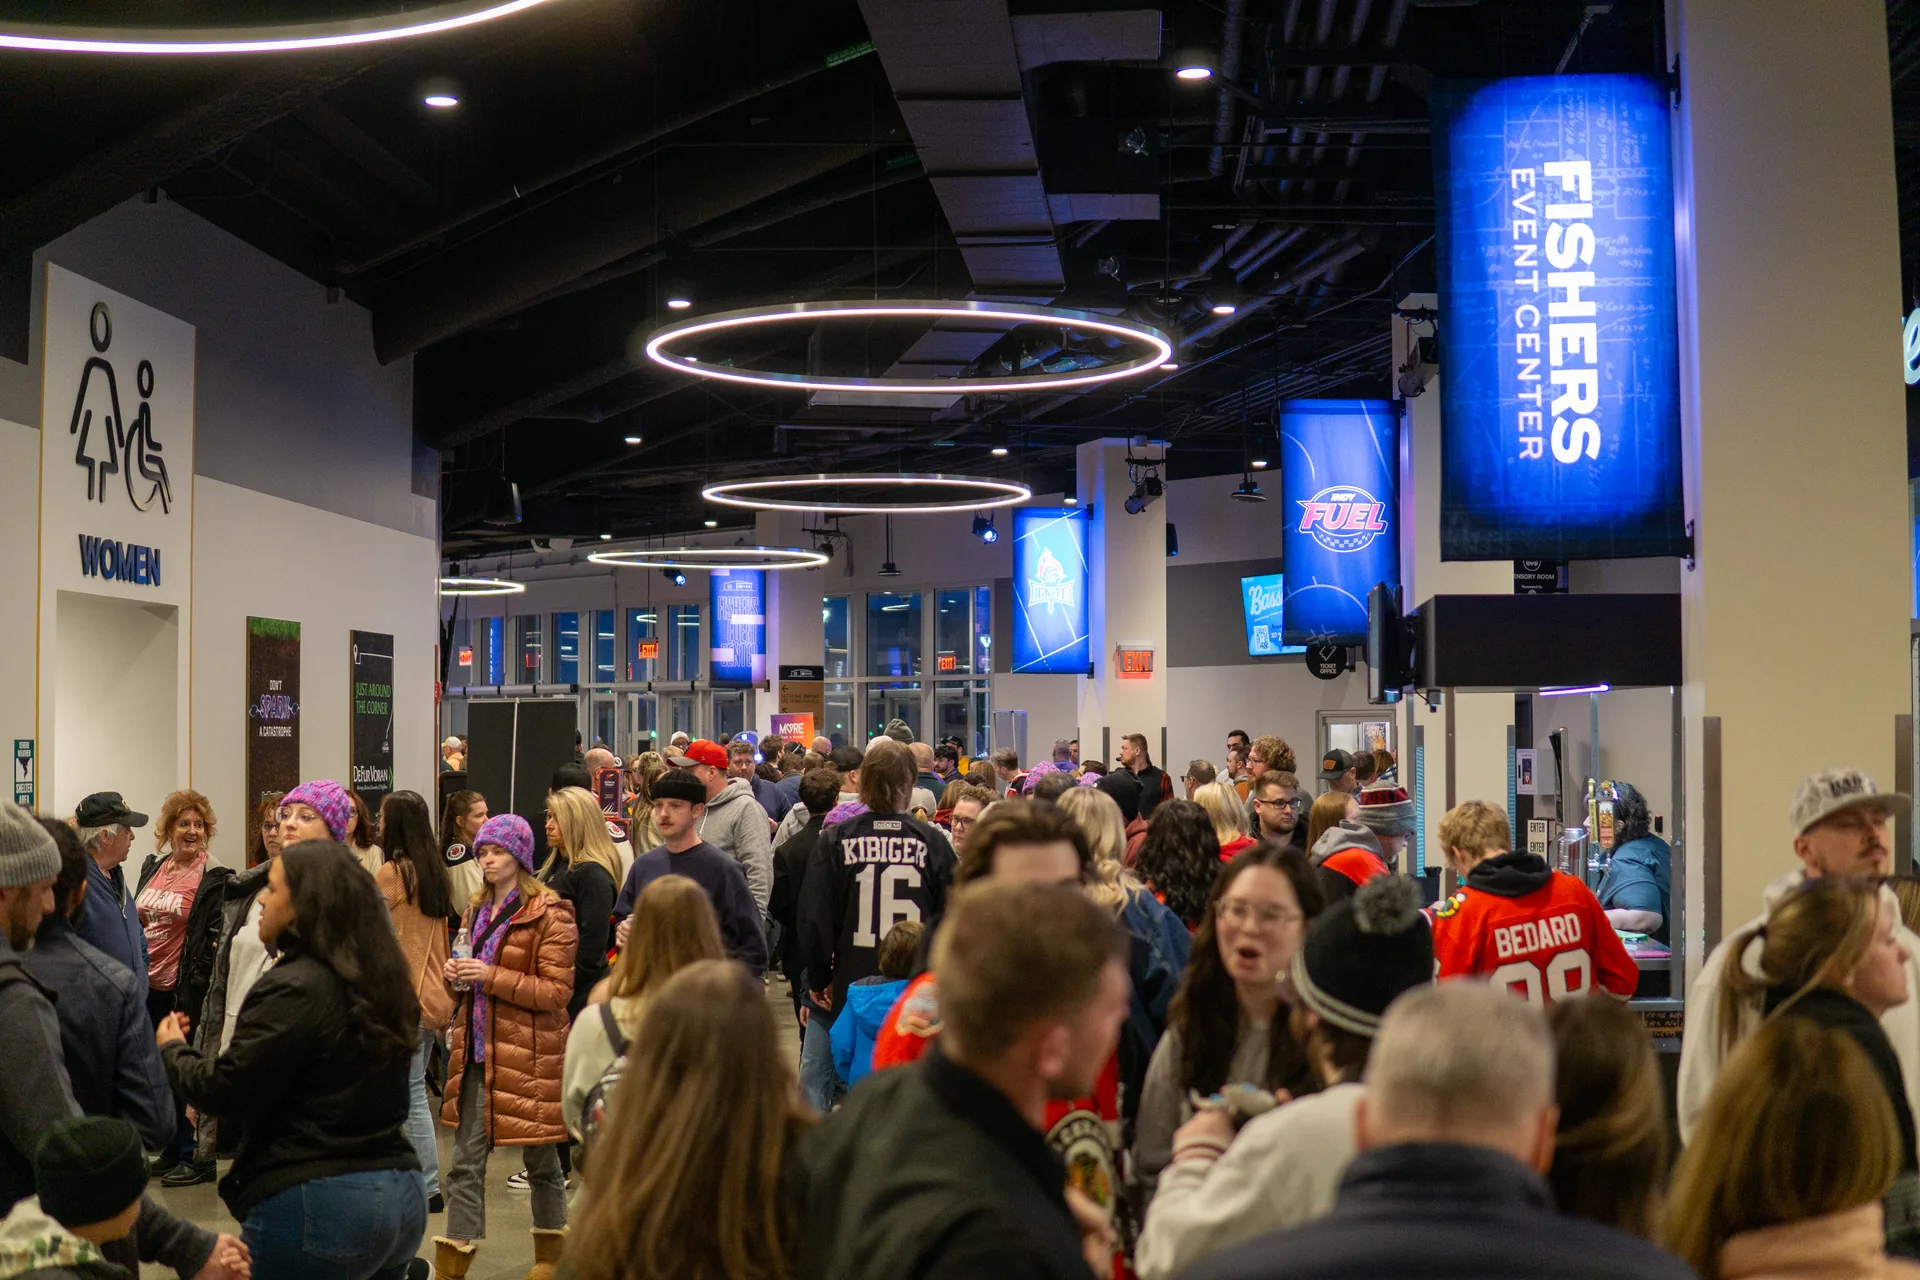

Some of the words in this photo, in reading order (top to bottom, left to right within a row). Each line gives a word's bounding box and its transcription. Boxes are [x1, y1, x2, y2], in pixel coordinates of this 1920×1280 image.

[1511, 168, 1538, 293] EVENT
[1544, 161, 1601, 464] FISHERS
[1515, 304, 1543, 459] CENTER
[1331, 493, 1356, 501] INDY
[1302, 503, 1383, 530] FUEL
[78, 533, 161, 587] WOMEN
[1031, 583, 1071, 602] IGNITE
[717, 596, 759, 620] FISHERS
[642, 644, 655, 658] EXIT
[941, 657, 953, 670] EXIT
[1124, 651, 1151, 671] EXIT
[269, 680, 282, 690] DON'T
[356, 682, 368, 699] JUST
[368, 683, 391, 698] AROUND
[356, 700, 366, 713] THE
[367, 701, 388, 714] CORNER
[259, 726, 263, 736] A
[263, 726, 292, 737] CATASTROPHE
[16, 783, 33, 793] SHELTER
[1530, 822, 1545, 833] ENTER
[841, 836, 928, 868] KIBIGER
[1530, 841, 1545, 852] ENTER
[853, 864, 921, 947] 16
[1494, 913, 1582, 958] BEDARD
